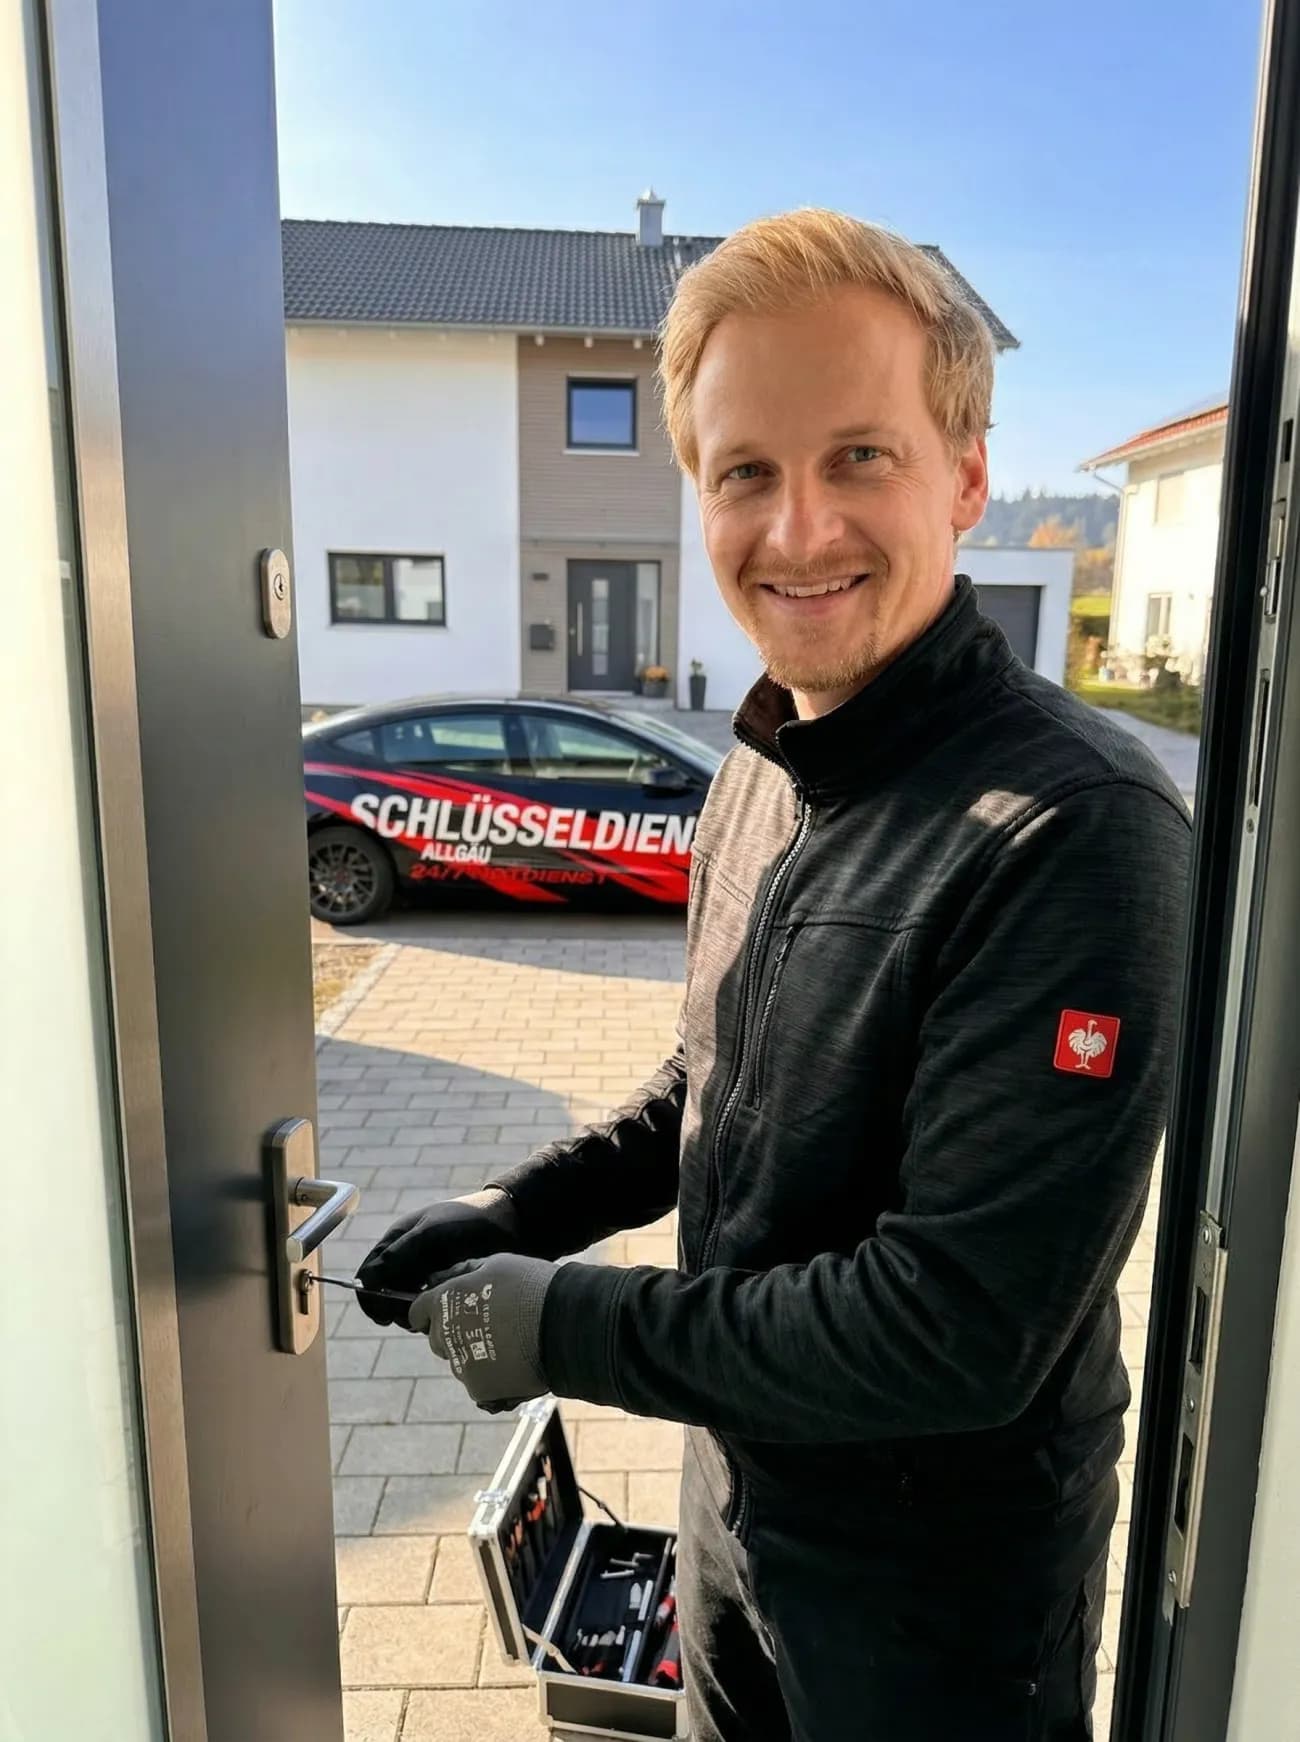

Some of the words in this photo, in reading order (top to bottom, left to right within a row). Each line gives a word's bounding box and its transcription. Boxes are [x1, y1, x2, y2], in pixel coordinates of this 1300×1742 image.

[351, 793, 697, 855] SCHLÜSSELDIEN
[421, 842, 492, 864] ALLGÄU
[409, 863, 464, 880] 24/7
